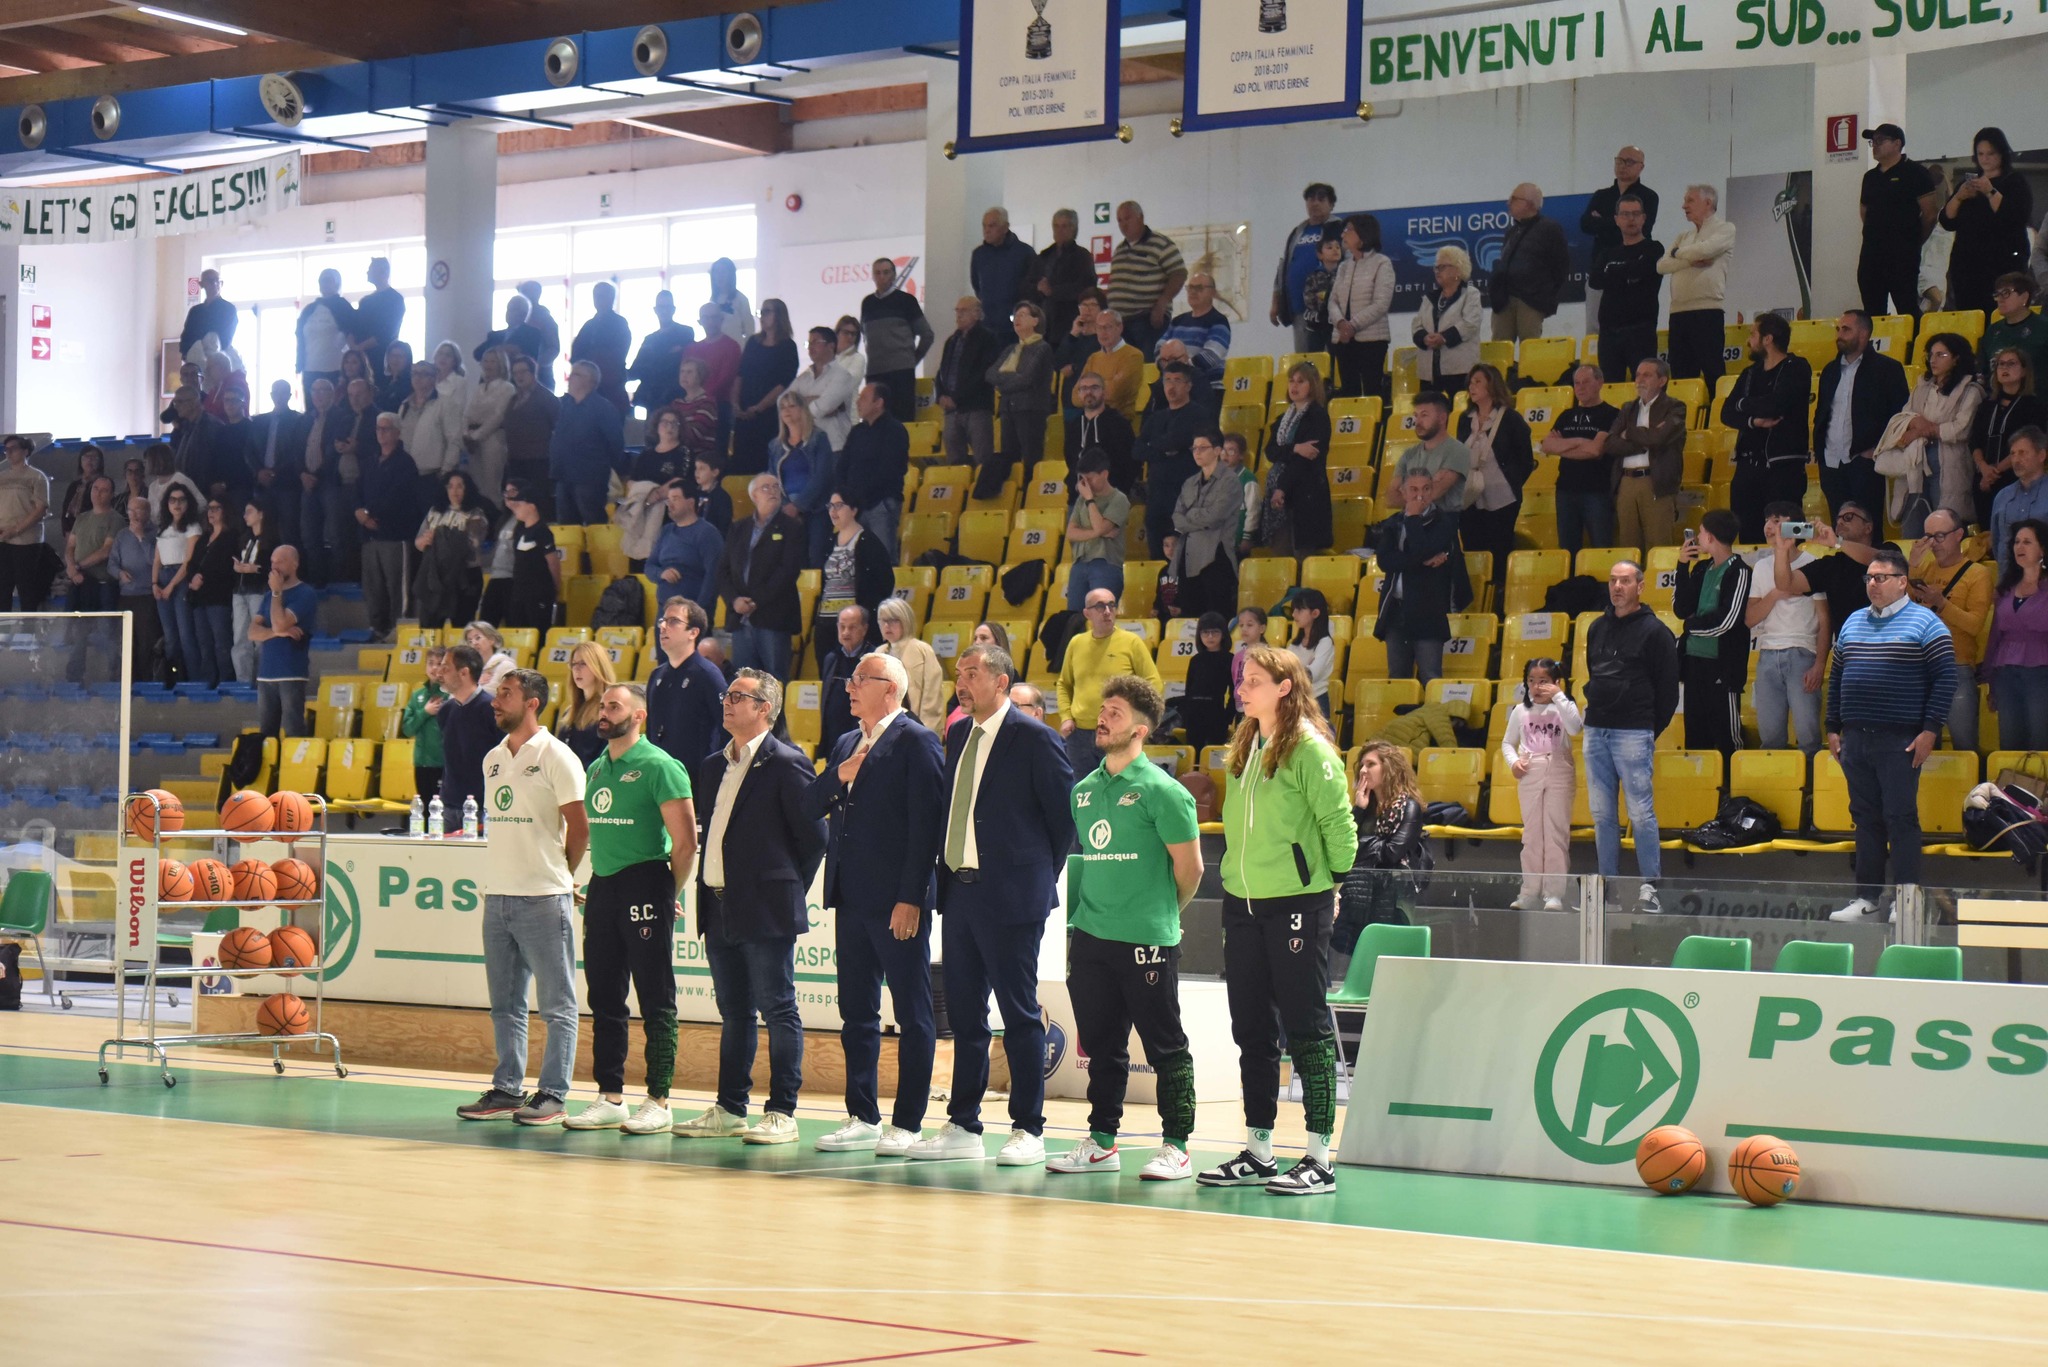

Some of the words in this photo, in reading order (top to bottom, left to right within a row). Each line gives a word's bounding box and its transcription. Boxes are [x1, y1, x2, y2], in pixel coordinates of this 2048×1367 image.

[1370, 11, 1604, 84] BENVENUTI
[1645, 5, 1703, 54] AL
[1230, 51, 1252, 62] COPPA
[1254, 48, 1275, 60] ITALIA
[1277, 44, 1314, 57] FEMMINILE
[1254, 63, 1289, 76] 2018-2019
[999, 76, 1020, 87] COPPA
[1022, 73, 1041, 84] ITALIA
[1043, 70, 1076, 83] FEMMINILE
[1233, 83, 1246, 94] ASD
[1264, 79, 1286, 91] VIRTUS
[1287, 77, 1309, 88] EIRENE
[1021, 89, 1054, 101] 2015-2016
[1024, 104, 1044, 116] VIRTUS
[1045, 102, 1065, 114] EIRENE
[23, 196, 92, 234] LET'S
[110, 193, 136, 231] GO
[154, 166, 267, 225] EAGLES!!!
[1407, 215, 1462, 235] FRENI
[821, 263, 870, 285] GIESS
[1724, 348, 1740, 361] 39
[1235, 377, 1249, 391] 31
[1528, 409, 1545, 422] 36
[1338, 418, 1354, 434] 33
[1336, 469, 1353, 483] 34
[932, 487, 946, 499] 27
[1043, 482, 1057, 494] 29
[1026, 533, 1041, 545] 29
[951, 588, 965, 600] 28
[1177, 642, 1193, 656] 33
[1450, 640, 1467, 654] 37
[404, 650, 417, 663] 19
[552, 650, 567, 662] 22
[1322, 761, 1334, 781] 3
[208, 862, 221, 895] Wilson
[379, 865, 478, 912] Pas
[129, 857, 145, 948] Wilson
[629, 904, 658, 922] S.C.
[1290, 913, 1302, 931] 3
[1134, 945, 1166, 965] G.Z.
[1076, 1060, 1090, 1070] LEG
[1310, 1073, 1327, 1121] RAGUSA
